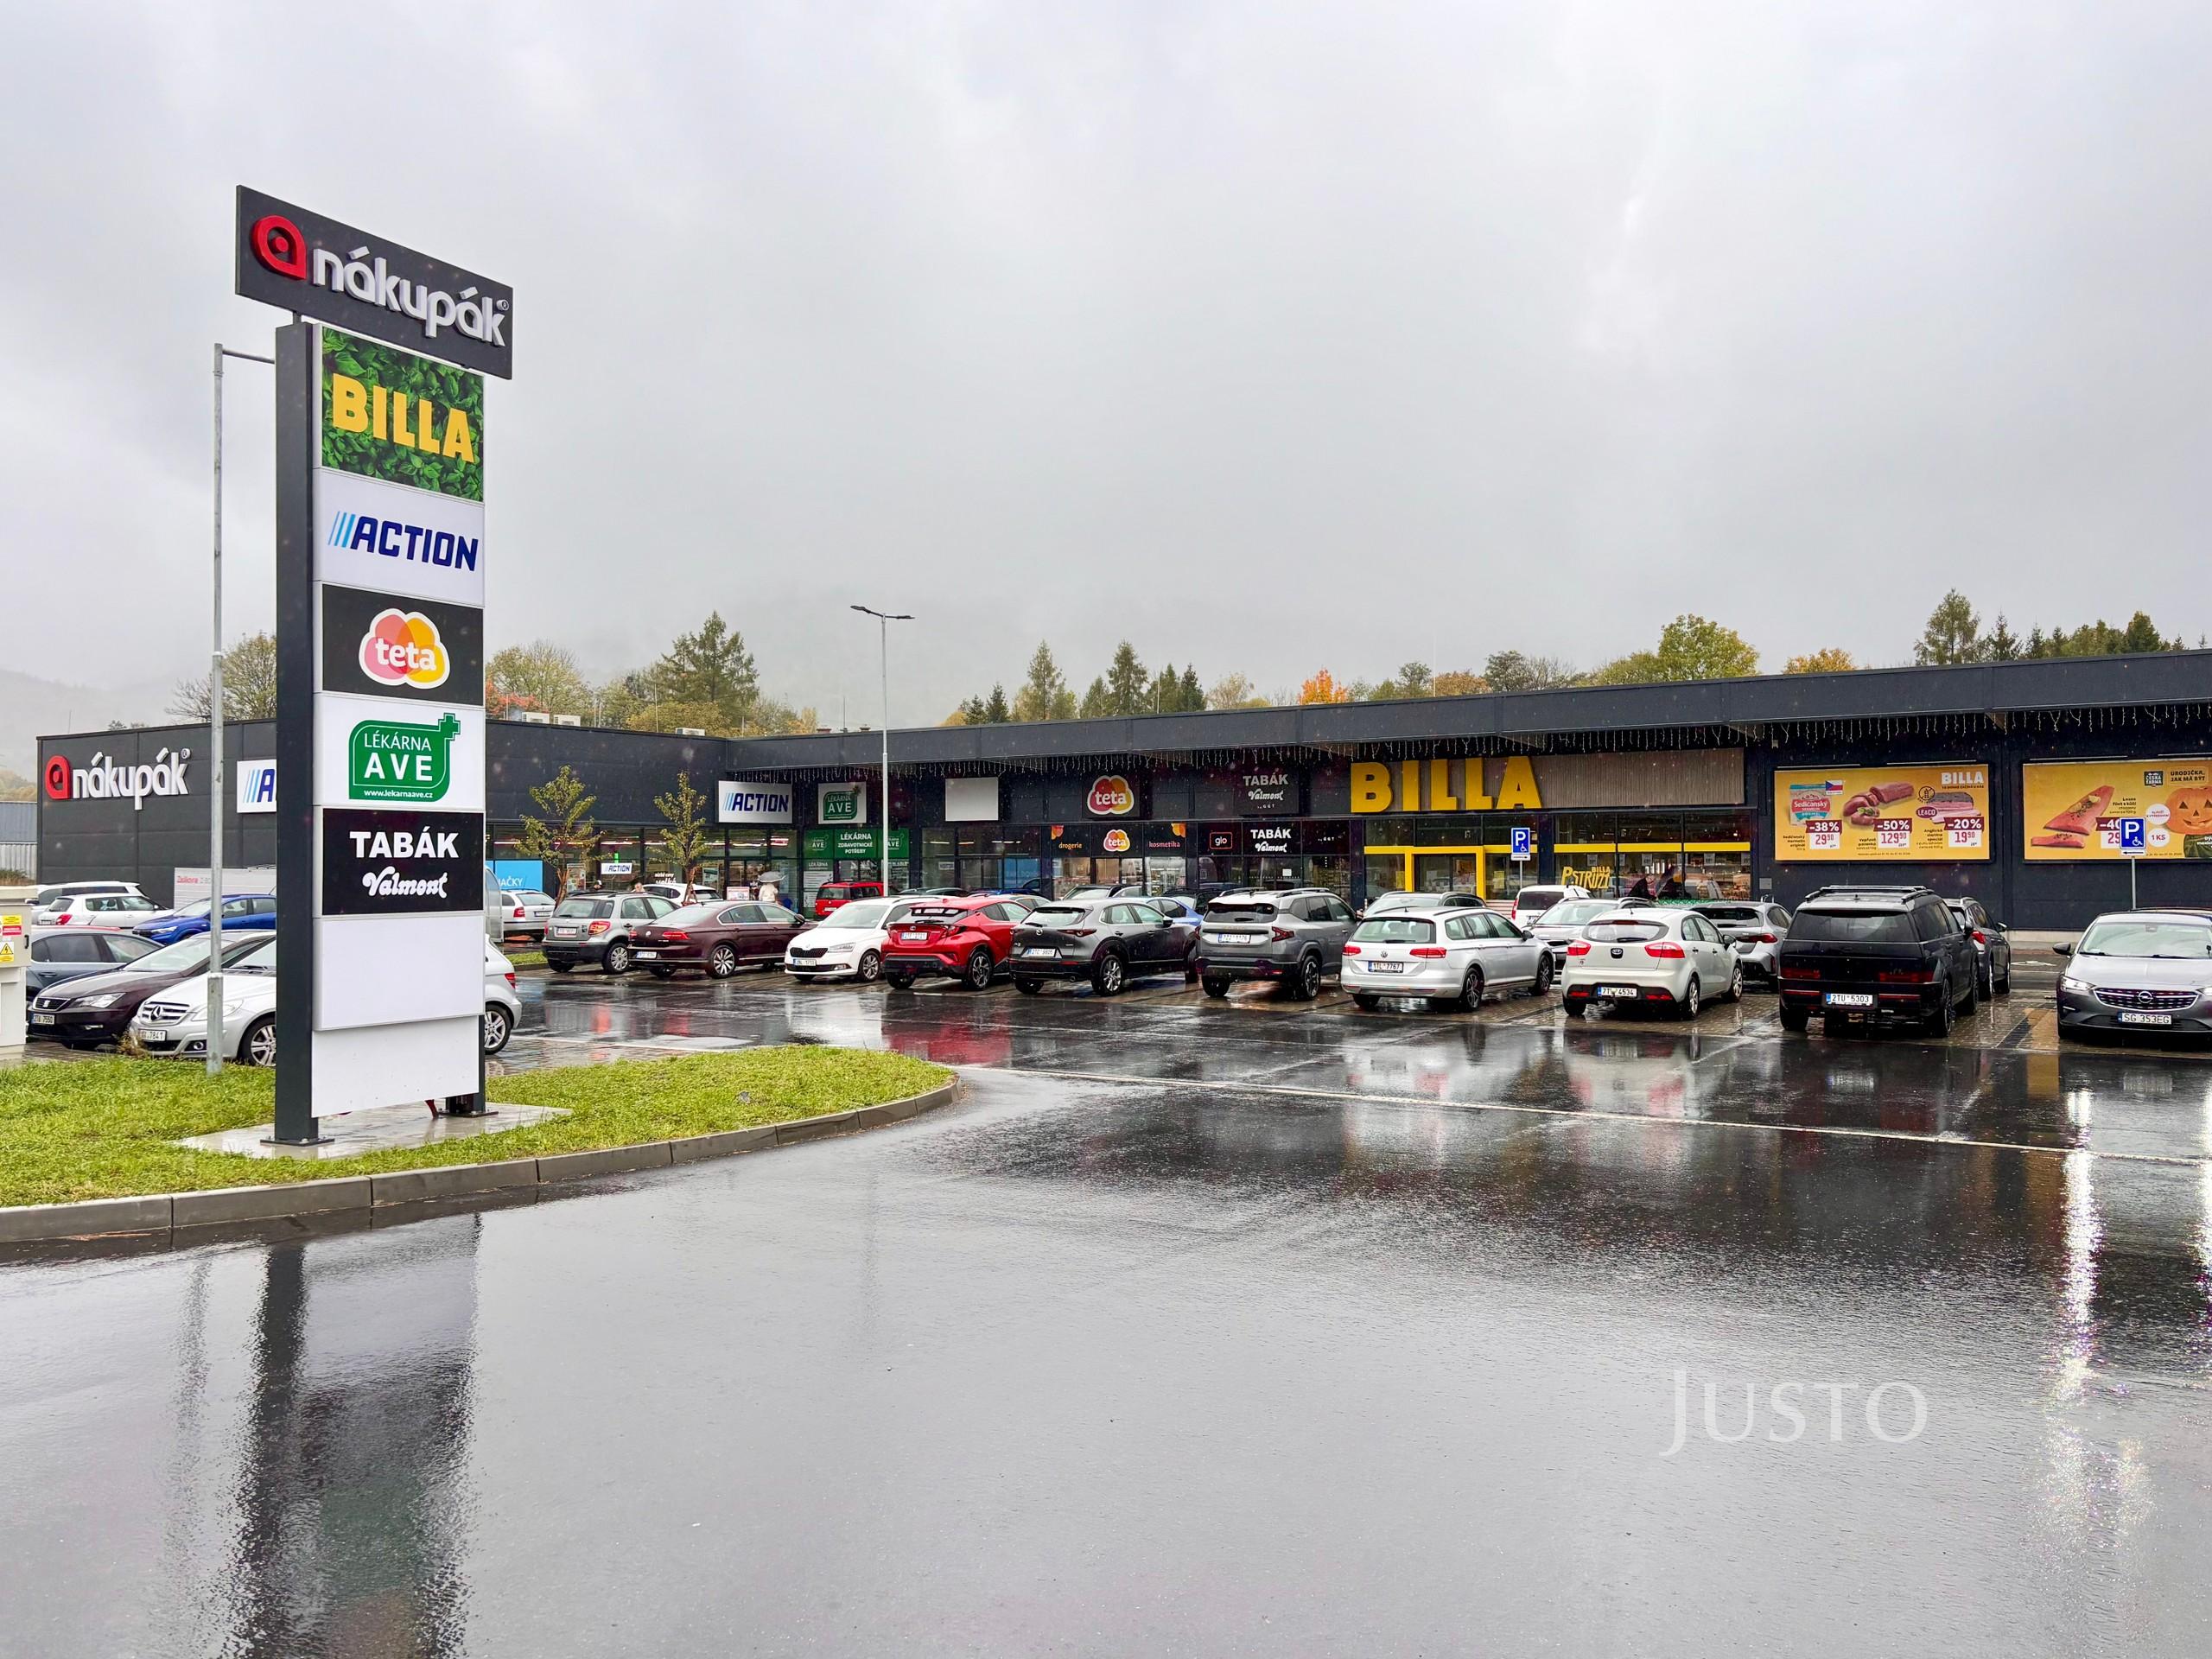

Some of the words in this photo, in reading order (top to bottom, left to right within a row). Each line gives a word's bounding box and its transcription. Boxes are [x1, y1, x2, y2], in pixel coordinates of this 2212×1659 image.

[313, 246, 505, 346] nákupák
[333, 373, 474, 463] BILLA
[350, 516, 479, 571] ACTION
[375, 638, 436, 671] teta
[364, 730, 431, 751] LÉKÁRNA
[364, 752, 433, 781] AVE
[73, 747, 188, 810] nákupák
[1243, 772, 1289, 786] TABÁK
[1351, 755, 1542, 813] BILLA
[1941, 771, 1985, 785] BILLA
[364, 789, 433, 798] www.lekarnaave.cz
[1095, 791, 1127, 805] teta
[1248, 788, 1285, 801] Valmont
[732, 792, 789, 812] ACTION
[828, 803, 852, 813] AVE
[1809, 822, 1840, 831] -38%
[1878, 820, 1910, 830] -50%
[1947, 818, 1981, 829] -20%
[2126, 821, 2140, 839] P
[841, 831, 872, 840] LÉKÁRNA
[1250, 827, 1292, 839] TABÁK
[1515, 831, 1526, 846] P
[349, 826, 459, 858] TABÁK
[1108, 838, 1126, 847] teta
[362, 866, 448, 899] Valmont
[2124, 1014, 2137, 1022] SG
[2139, 1014, 2170, 1024] 353EG
